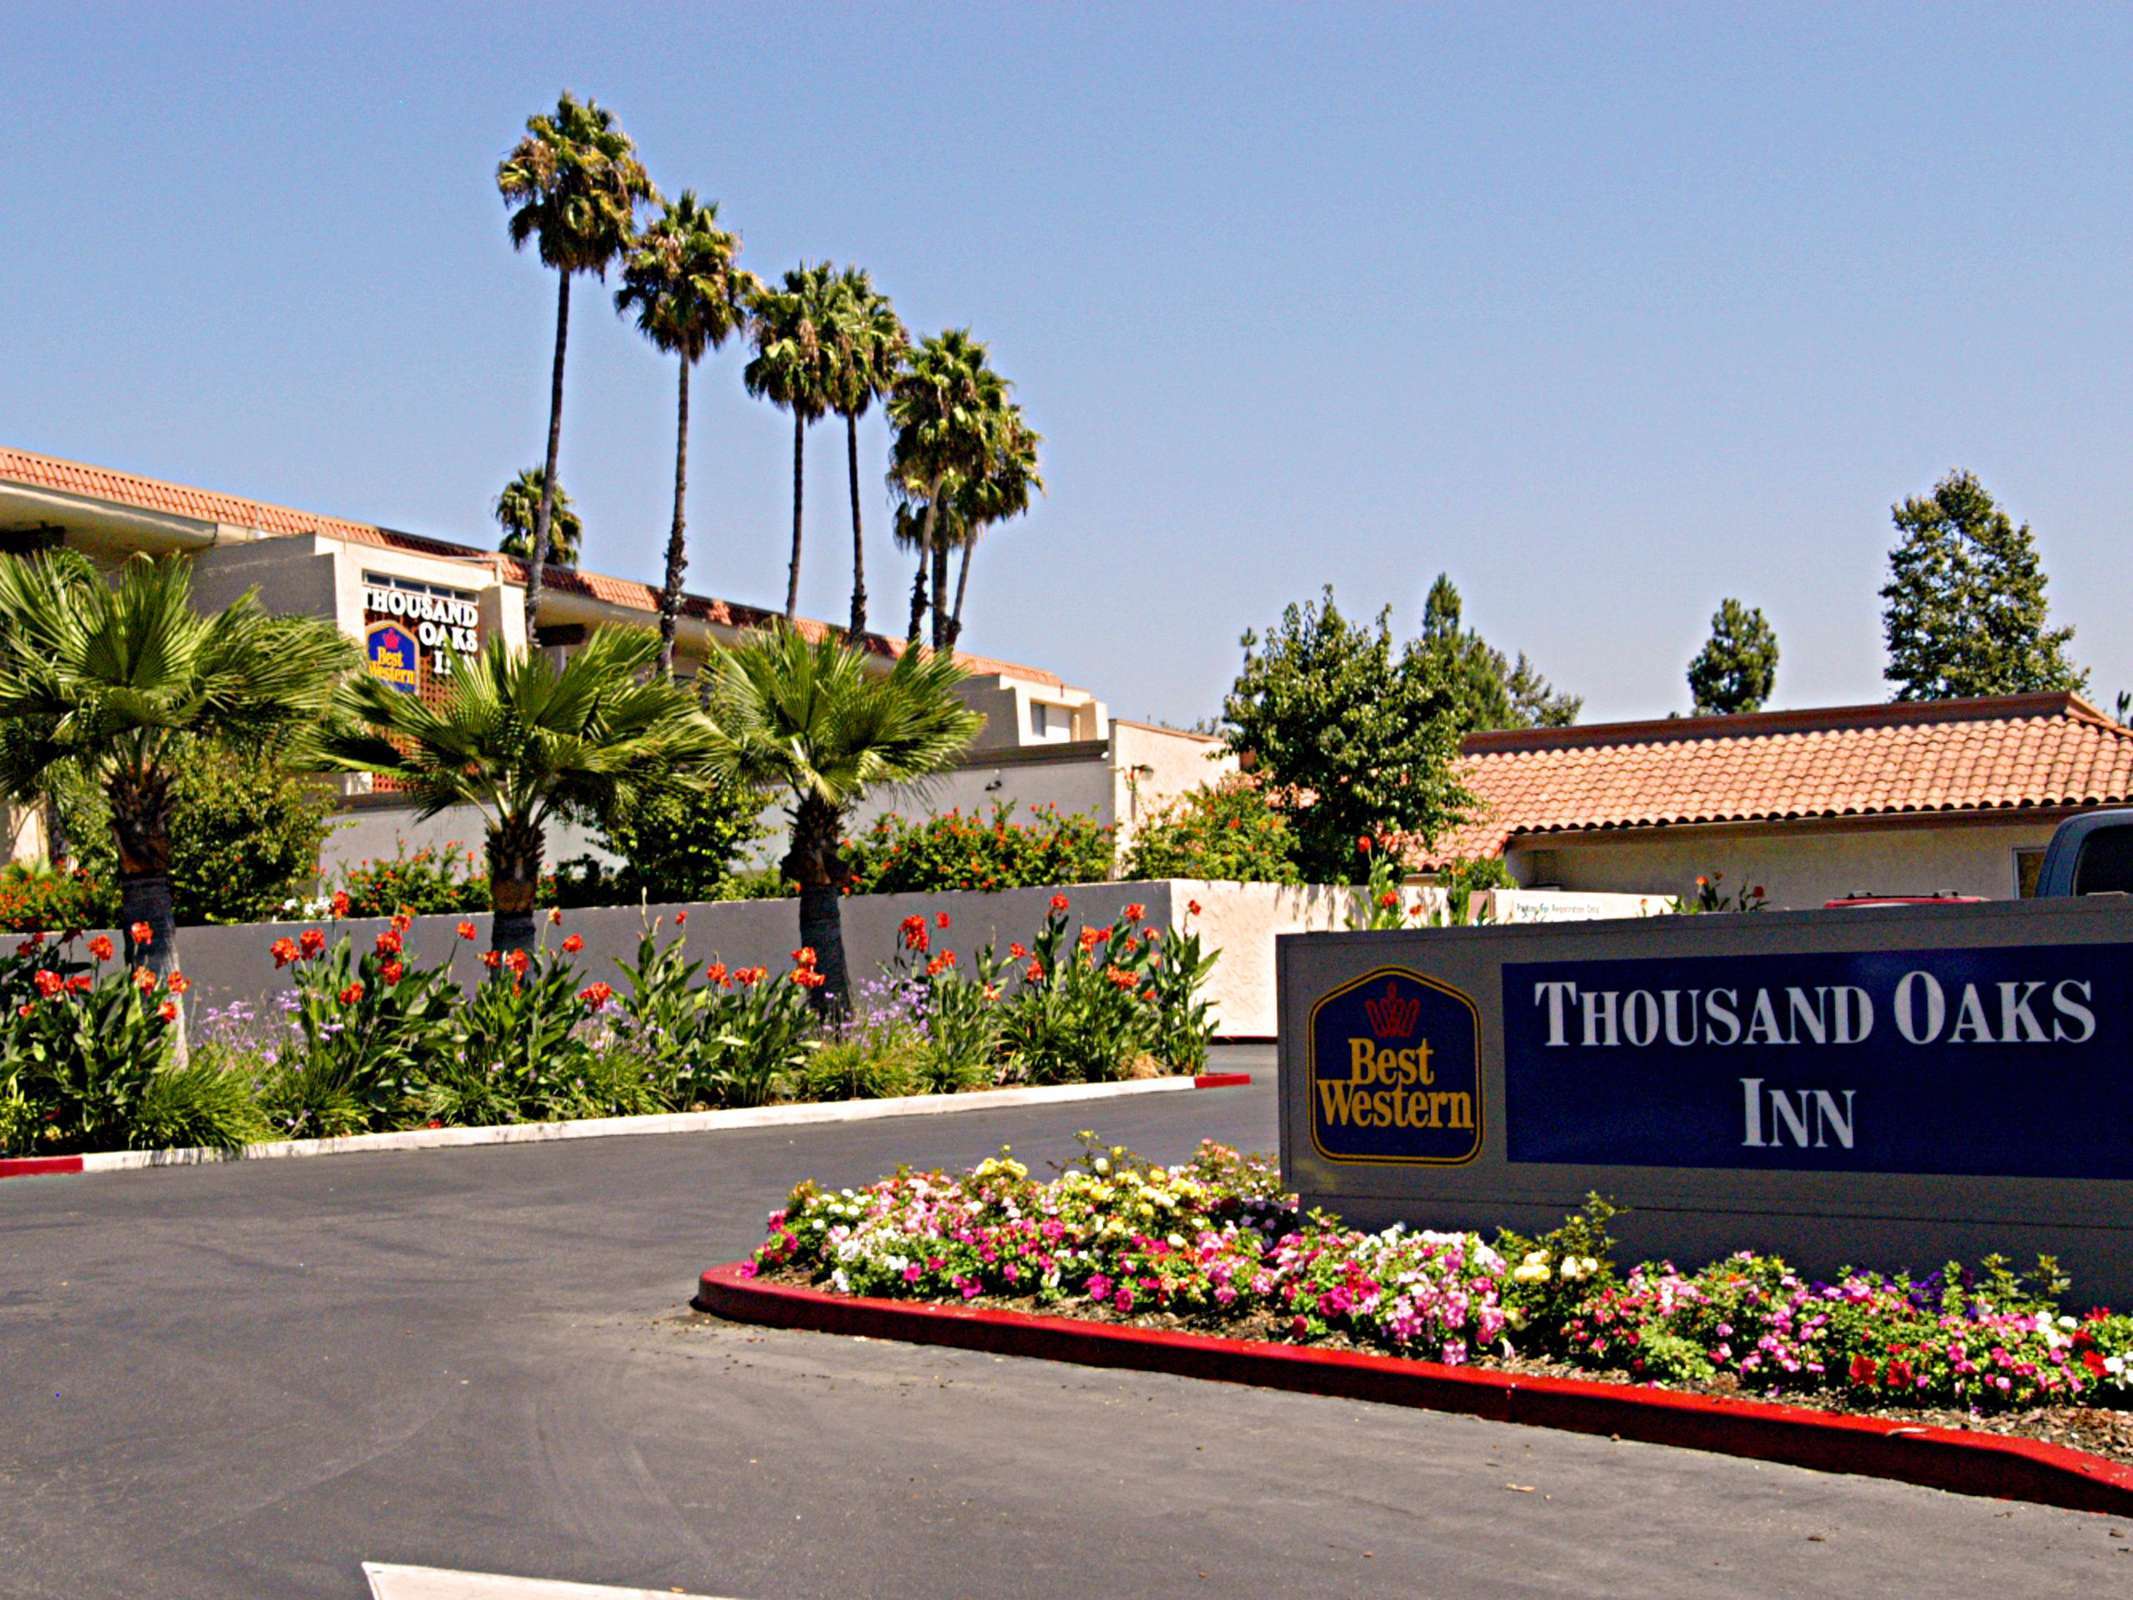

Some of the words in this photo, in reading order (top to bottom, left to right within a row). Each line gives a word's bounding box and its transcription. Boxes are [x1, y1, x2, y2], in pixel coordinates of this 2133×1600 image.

[418, 621, 478, 652] OAKS
[377, 646, 404, 667] Best
[1348, 1037, 1434, 1085] Best
[1317, 1079, 1474, 1129] Western
